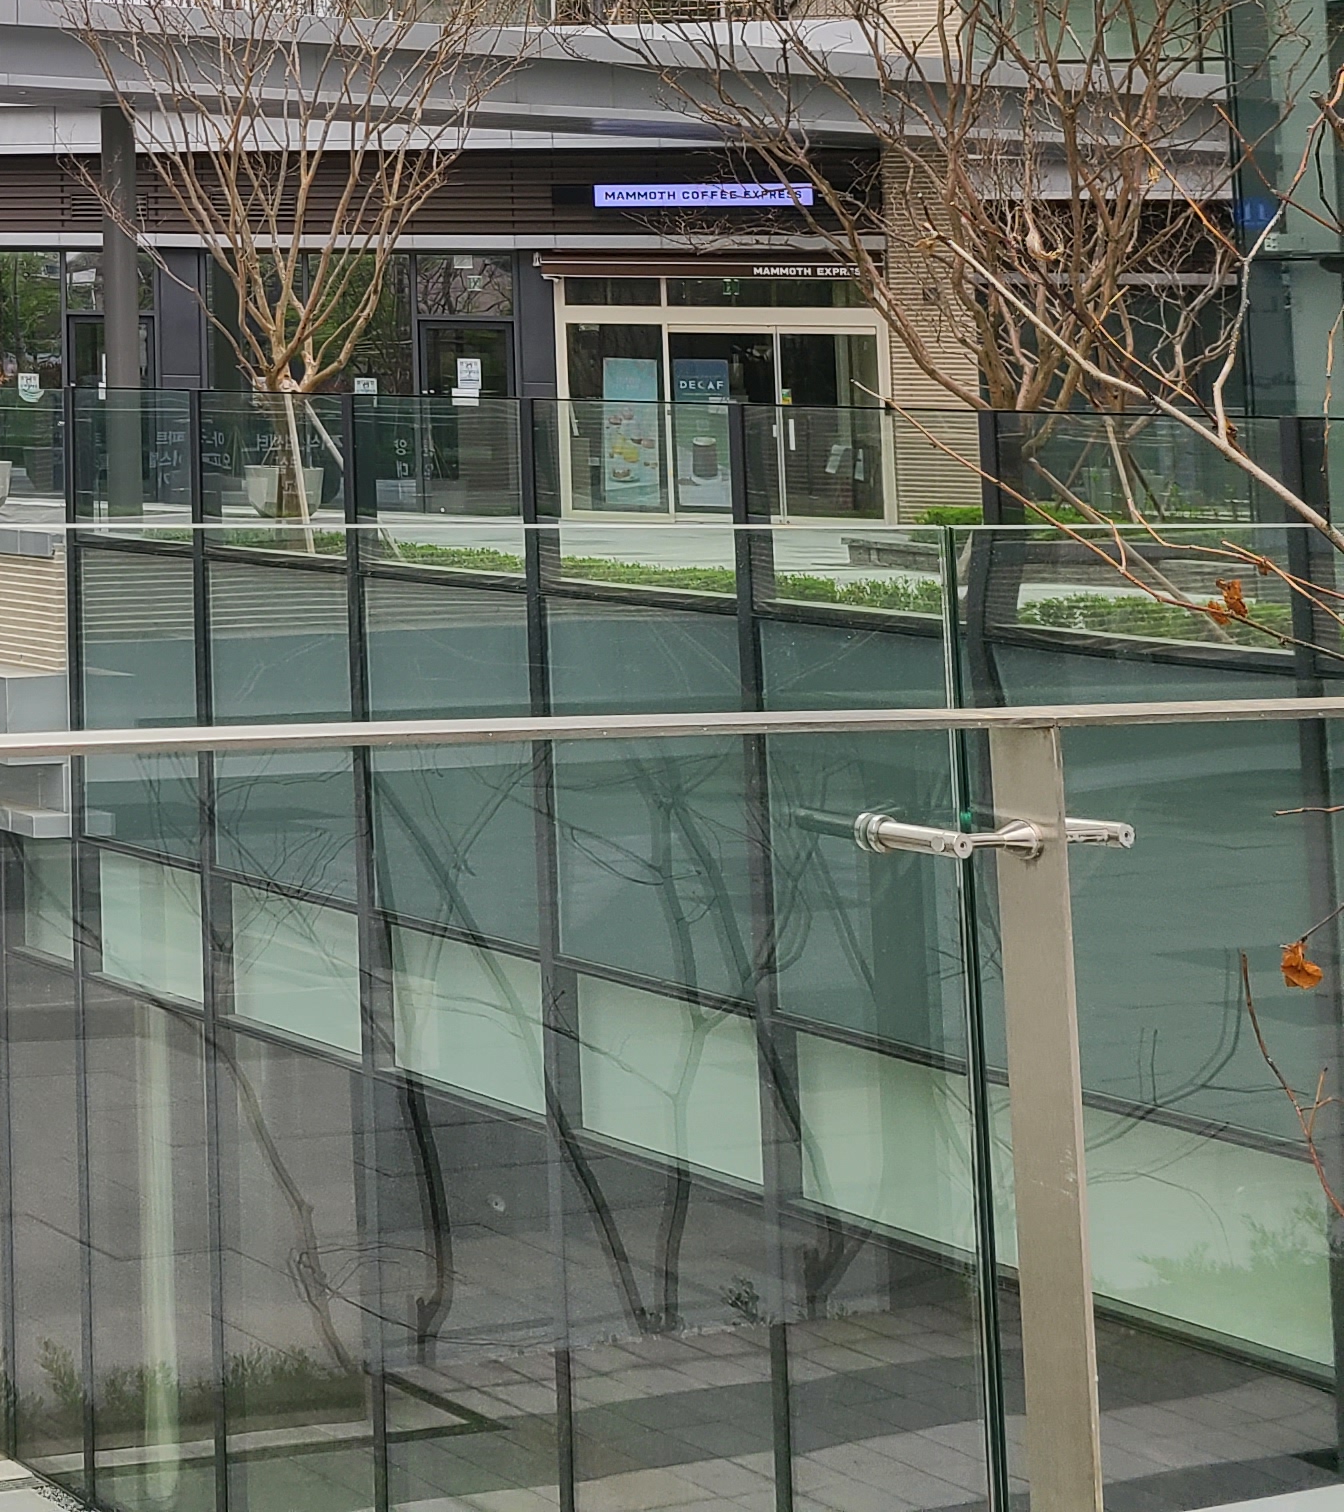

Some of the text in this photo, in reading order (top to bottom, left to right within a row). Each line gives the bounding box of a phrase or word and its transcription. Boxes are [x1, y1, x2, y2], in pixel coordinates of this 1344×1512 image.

[604, 190, 676, 201] MAMMOTH
[682, 190, 738, 201] COFFEE
[753, 266, 812, 277] MAMMOTH
[679, 380, 725, 390] DECAF
